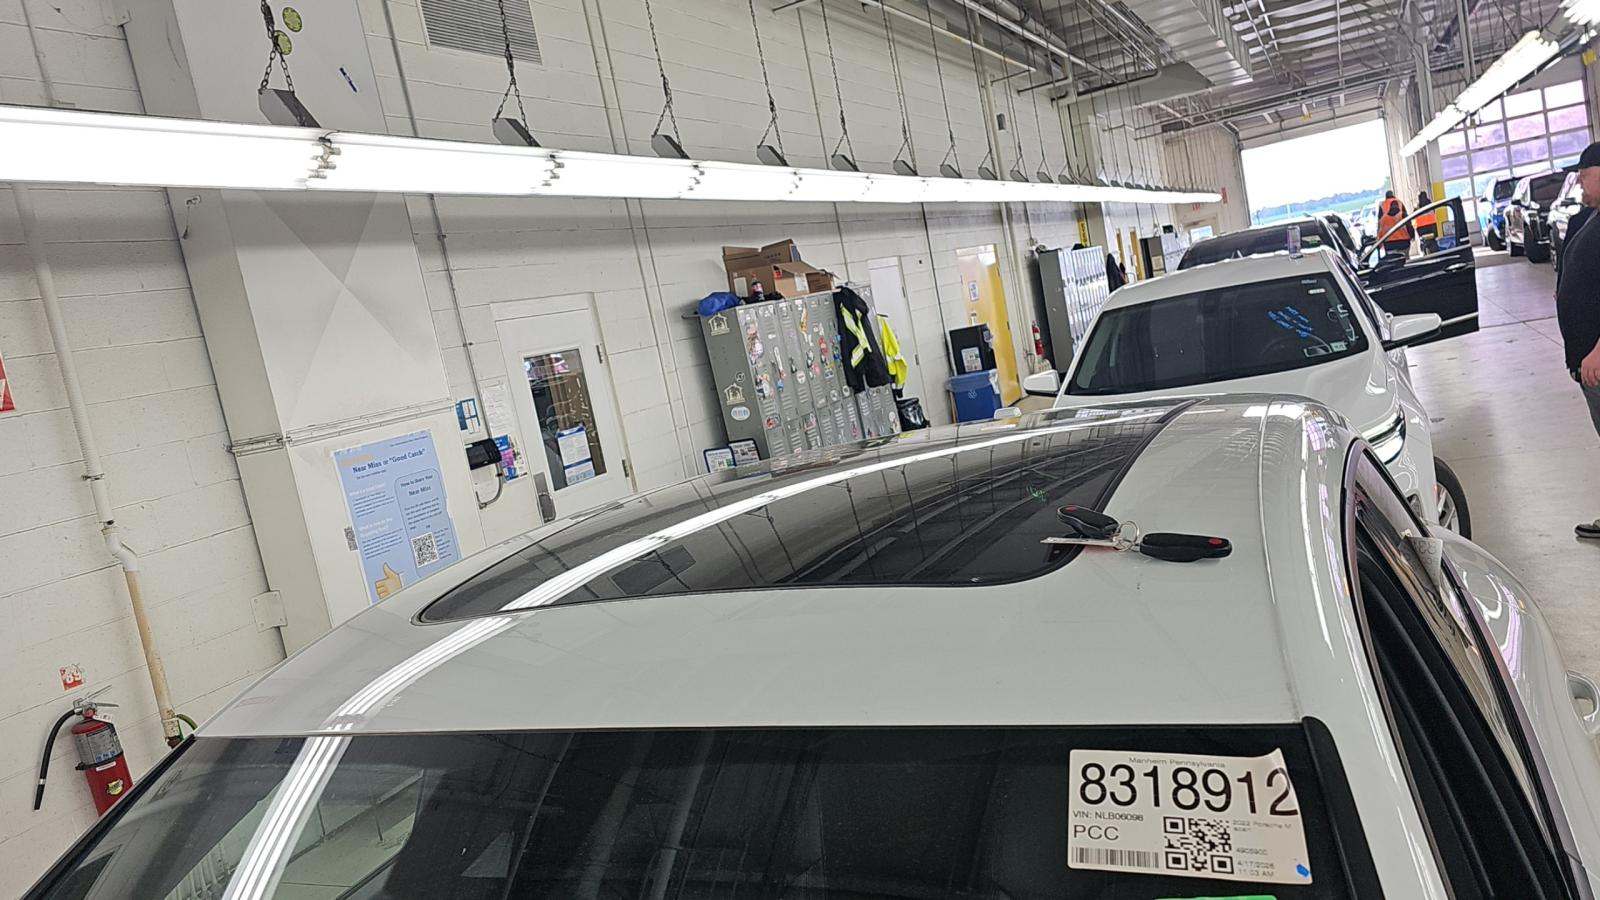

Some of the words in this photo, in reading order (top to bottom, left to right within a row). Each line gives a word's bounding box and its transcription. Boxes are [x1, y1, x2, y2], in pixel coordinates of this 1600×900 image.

[352, 465, 367, 474] Near
[367, 461, 382, 470] Miss
[1129, 757, 1168, 765] Manheim
[1170, 759, 1226, 768] Pennsylvania
[1079, 763, 1299, 816] 8318912
[1072, 810, 1092, 818] VIN:
[1073, 824, 1119, 841] PCC
